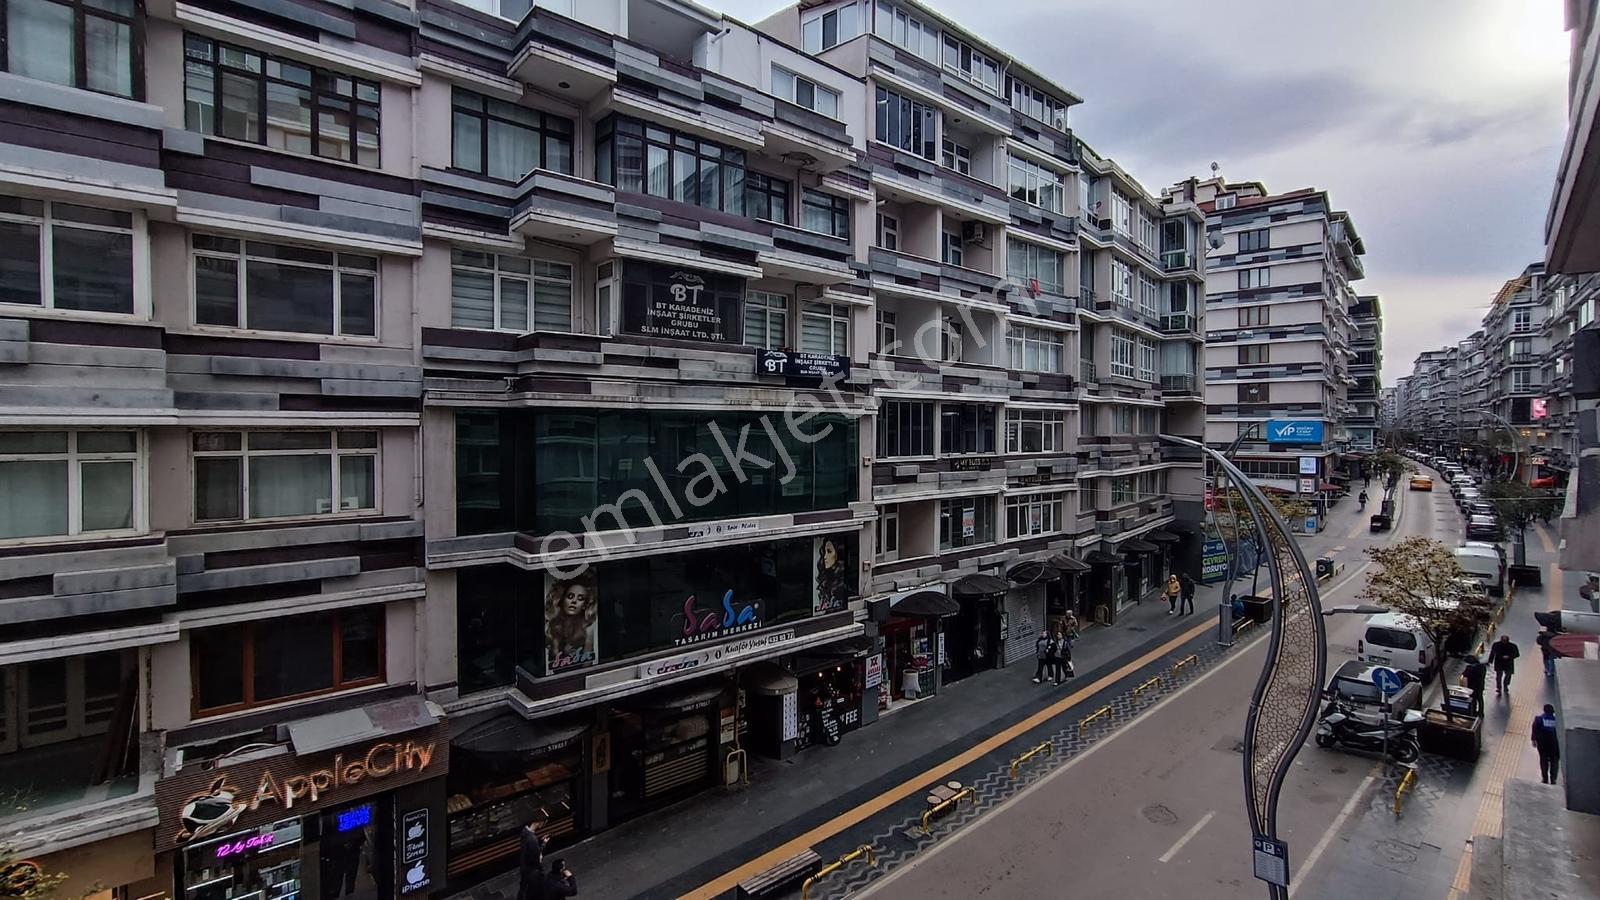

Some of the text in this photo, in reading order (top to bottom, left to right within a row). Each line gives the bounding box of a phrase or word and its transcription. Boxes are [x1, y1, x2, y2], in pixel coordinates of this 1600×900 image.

[669, 283, 704, 305] BT
[647, 307, 721, 324] İNŞAAT ŞİRKETLER
[656, 302, 714, 315] BT KARADENİZ
[671, 319, 699, 328] GRUBU
[641, 325, 659, 334] SLM
[661, 326, 690, 337] İNŞAAT
[692, 331, 709, 339] LTD.
[764, 358, 788, 373] BT
[674, 619, 762, 646] TASARIM MERKEZİ
[249, 742, 436, 810] AppleCity
[401, 878, 431, 894] iPhone
